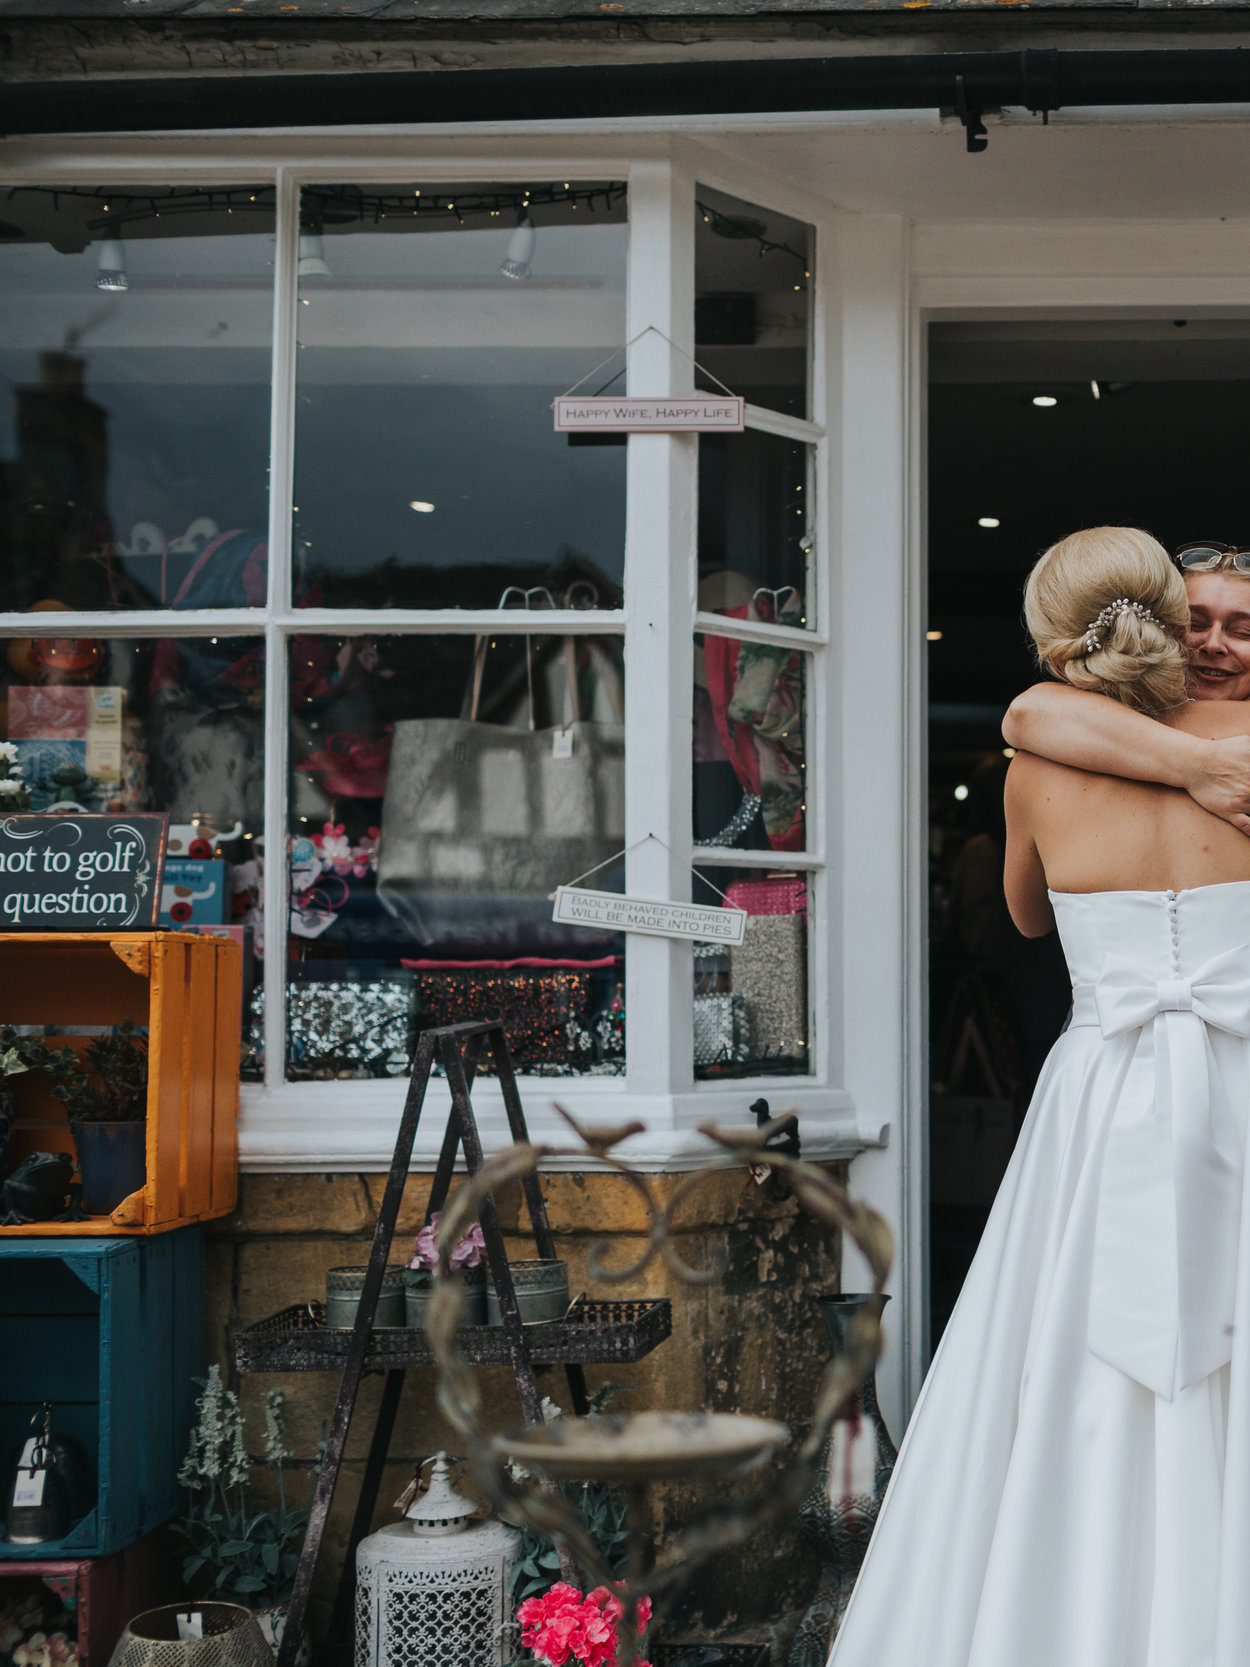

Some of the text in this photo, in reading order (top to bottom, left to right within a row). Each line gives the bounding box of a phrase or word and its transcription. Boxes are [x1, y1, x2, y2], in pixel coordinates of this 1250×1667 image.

[566, 407, 732, 419] HAPPY WIFE, HAPPY LIFE
[43, 846, 71, 873] to
[75, 841, 137, 881] golf
[3, 884, 128, 923] question
[571, 895, 732, 924] BADLY BEHAVED CHILDREN
[571, 907, 732, 936] WILL BE MADE INTO PIES
